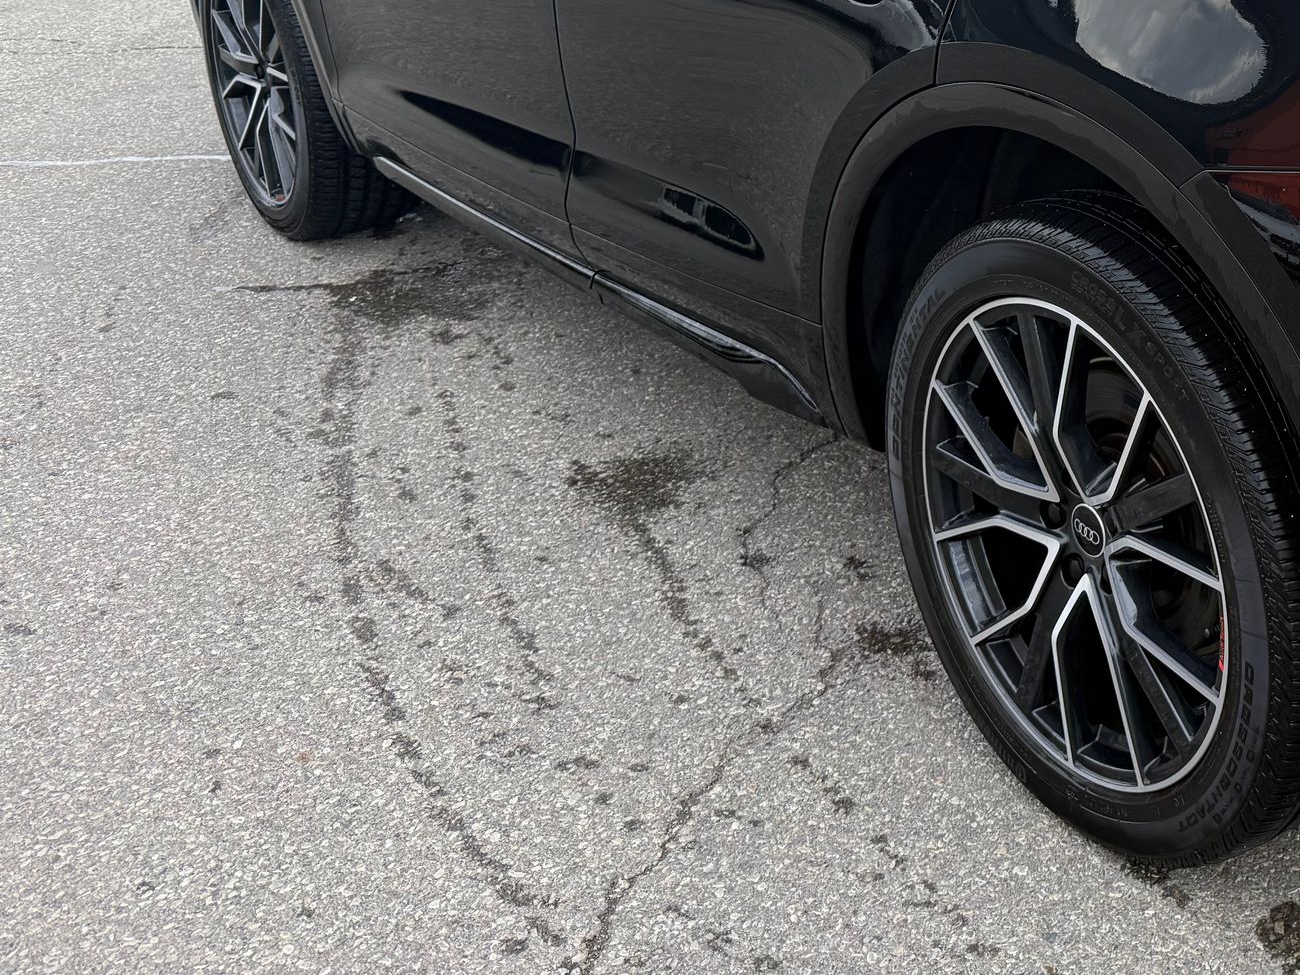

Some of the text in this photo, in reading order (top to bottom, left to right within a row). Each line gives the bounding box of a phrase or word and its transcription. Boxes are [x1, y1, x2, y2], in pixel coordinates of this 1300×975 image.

[890, 287, 946, 462] CONTINENTAL
[1145, 341, 1190, 402] SPORT
[1178, 661, 1256, 833] CROSSCONTACT
